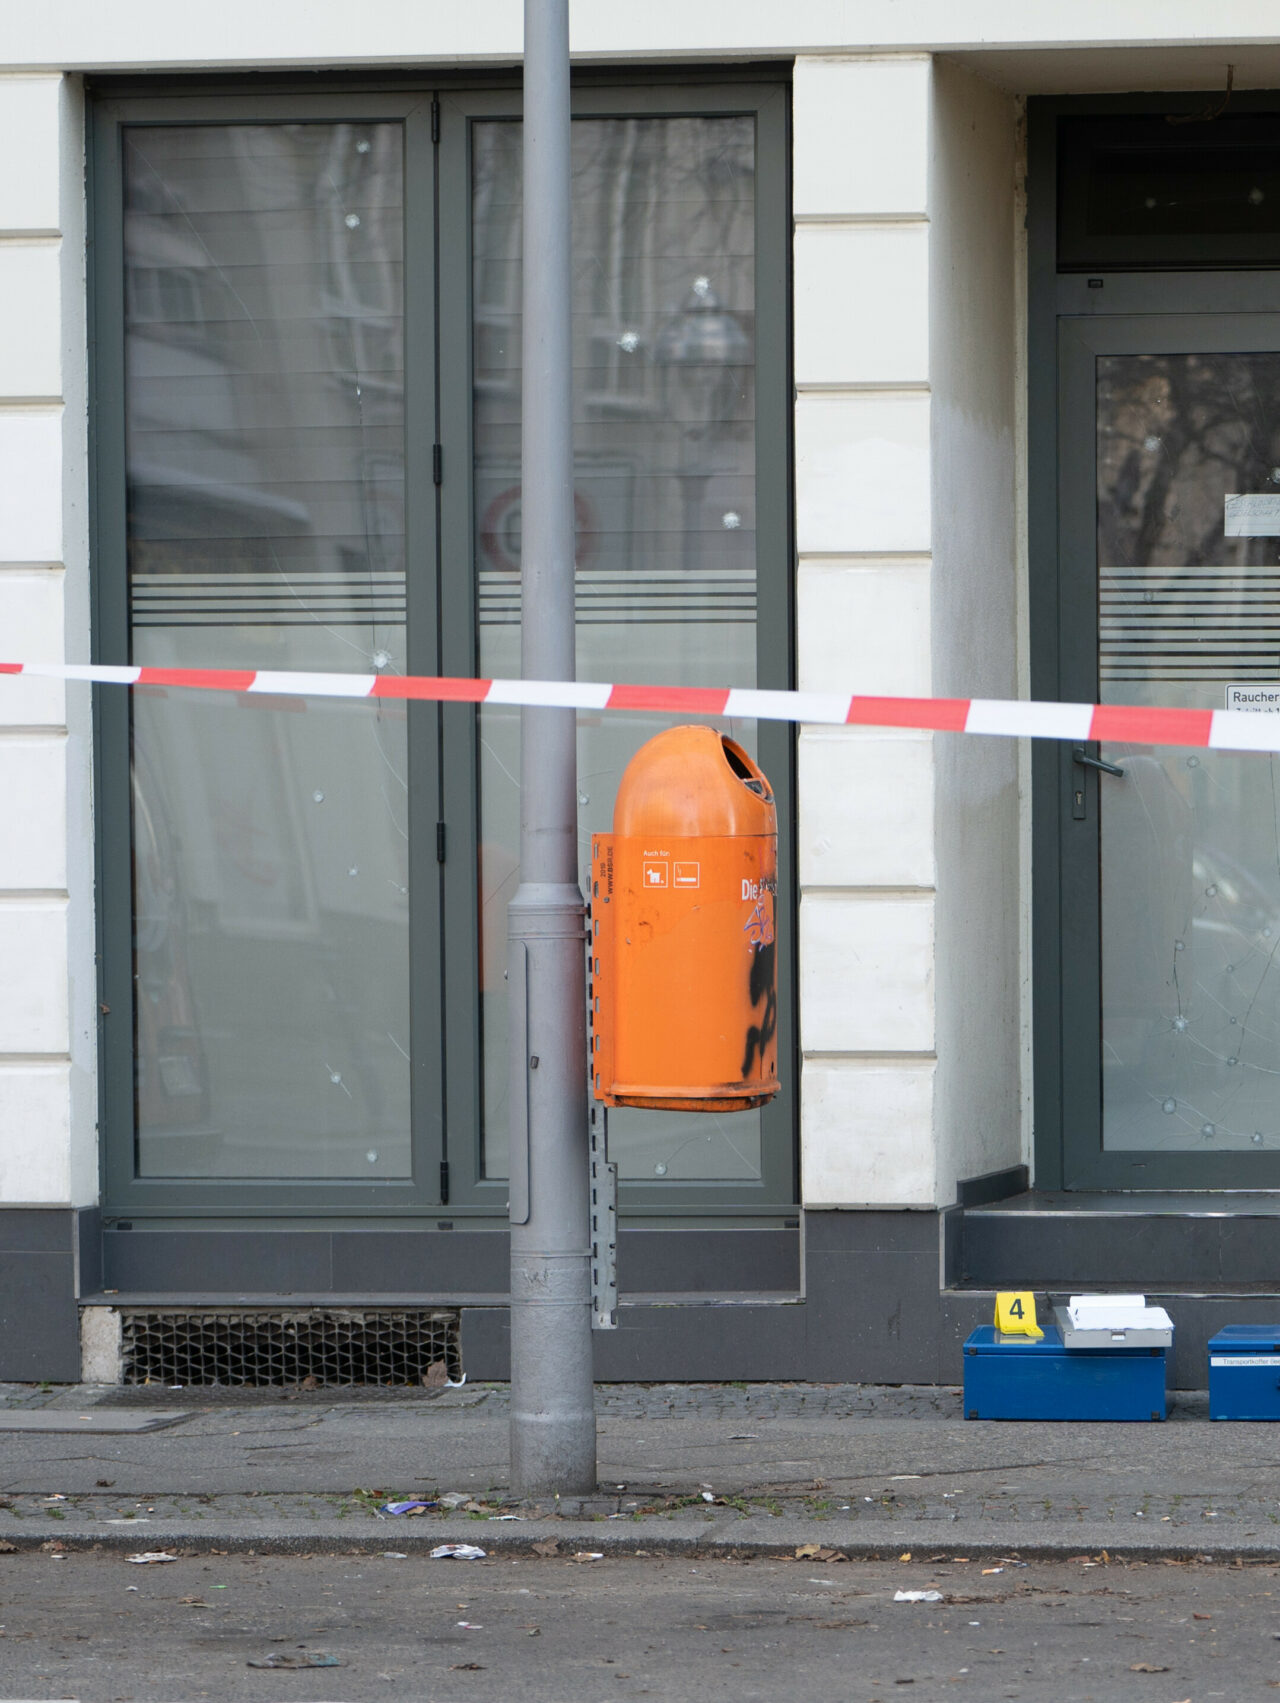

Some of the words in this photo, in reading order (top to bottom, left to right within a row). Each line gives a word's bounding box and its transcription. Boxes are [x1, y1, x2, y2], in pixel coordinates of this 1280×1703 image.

[741, 878, 758, 901] Die
[1009, 1298, 1025, 1320] 4
[1223, 1358, 1269, 1366] Transportkoffer
